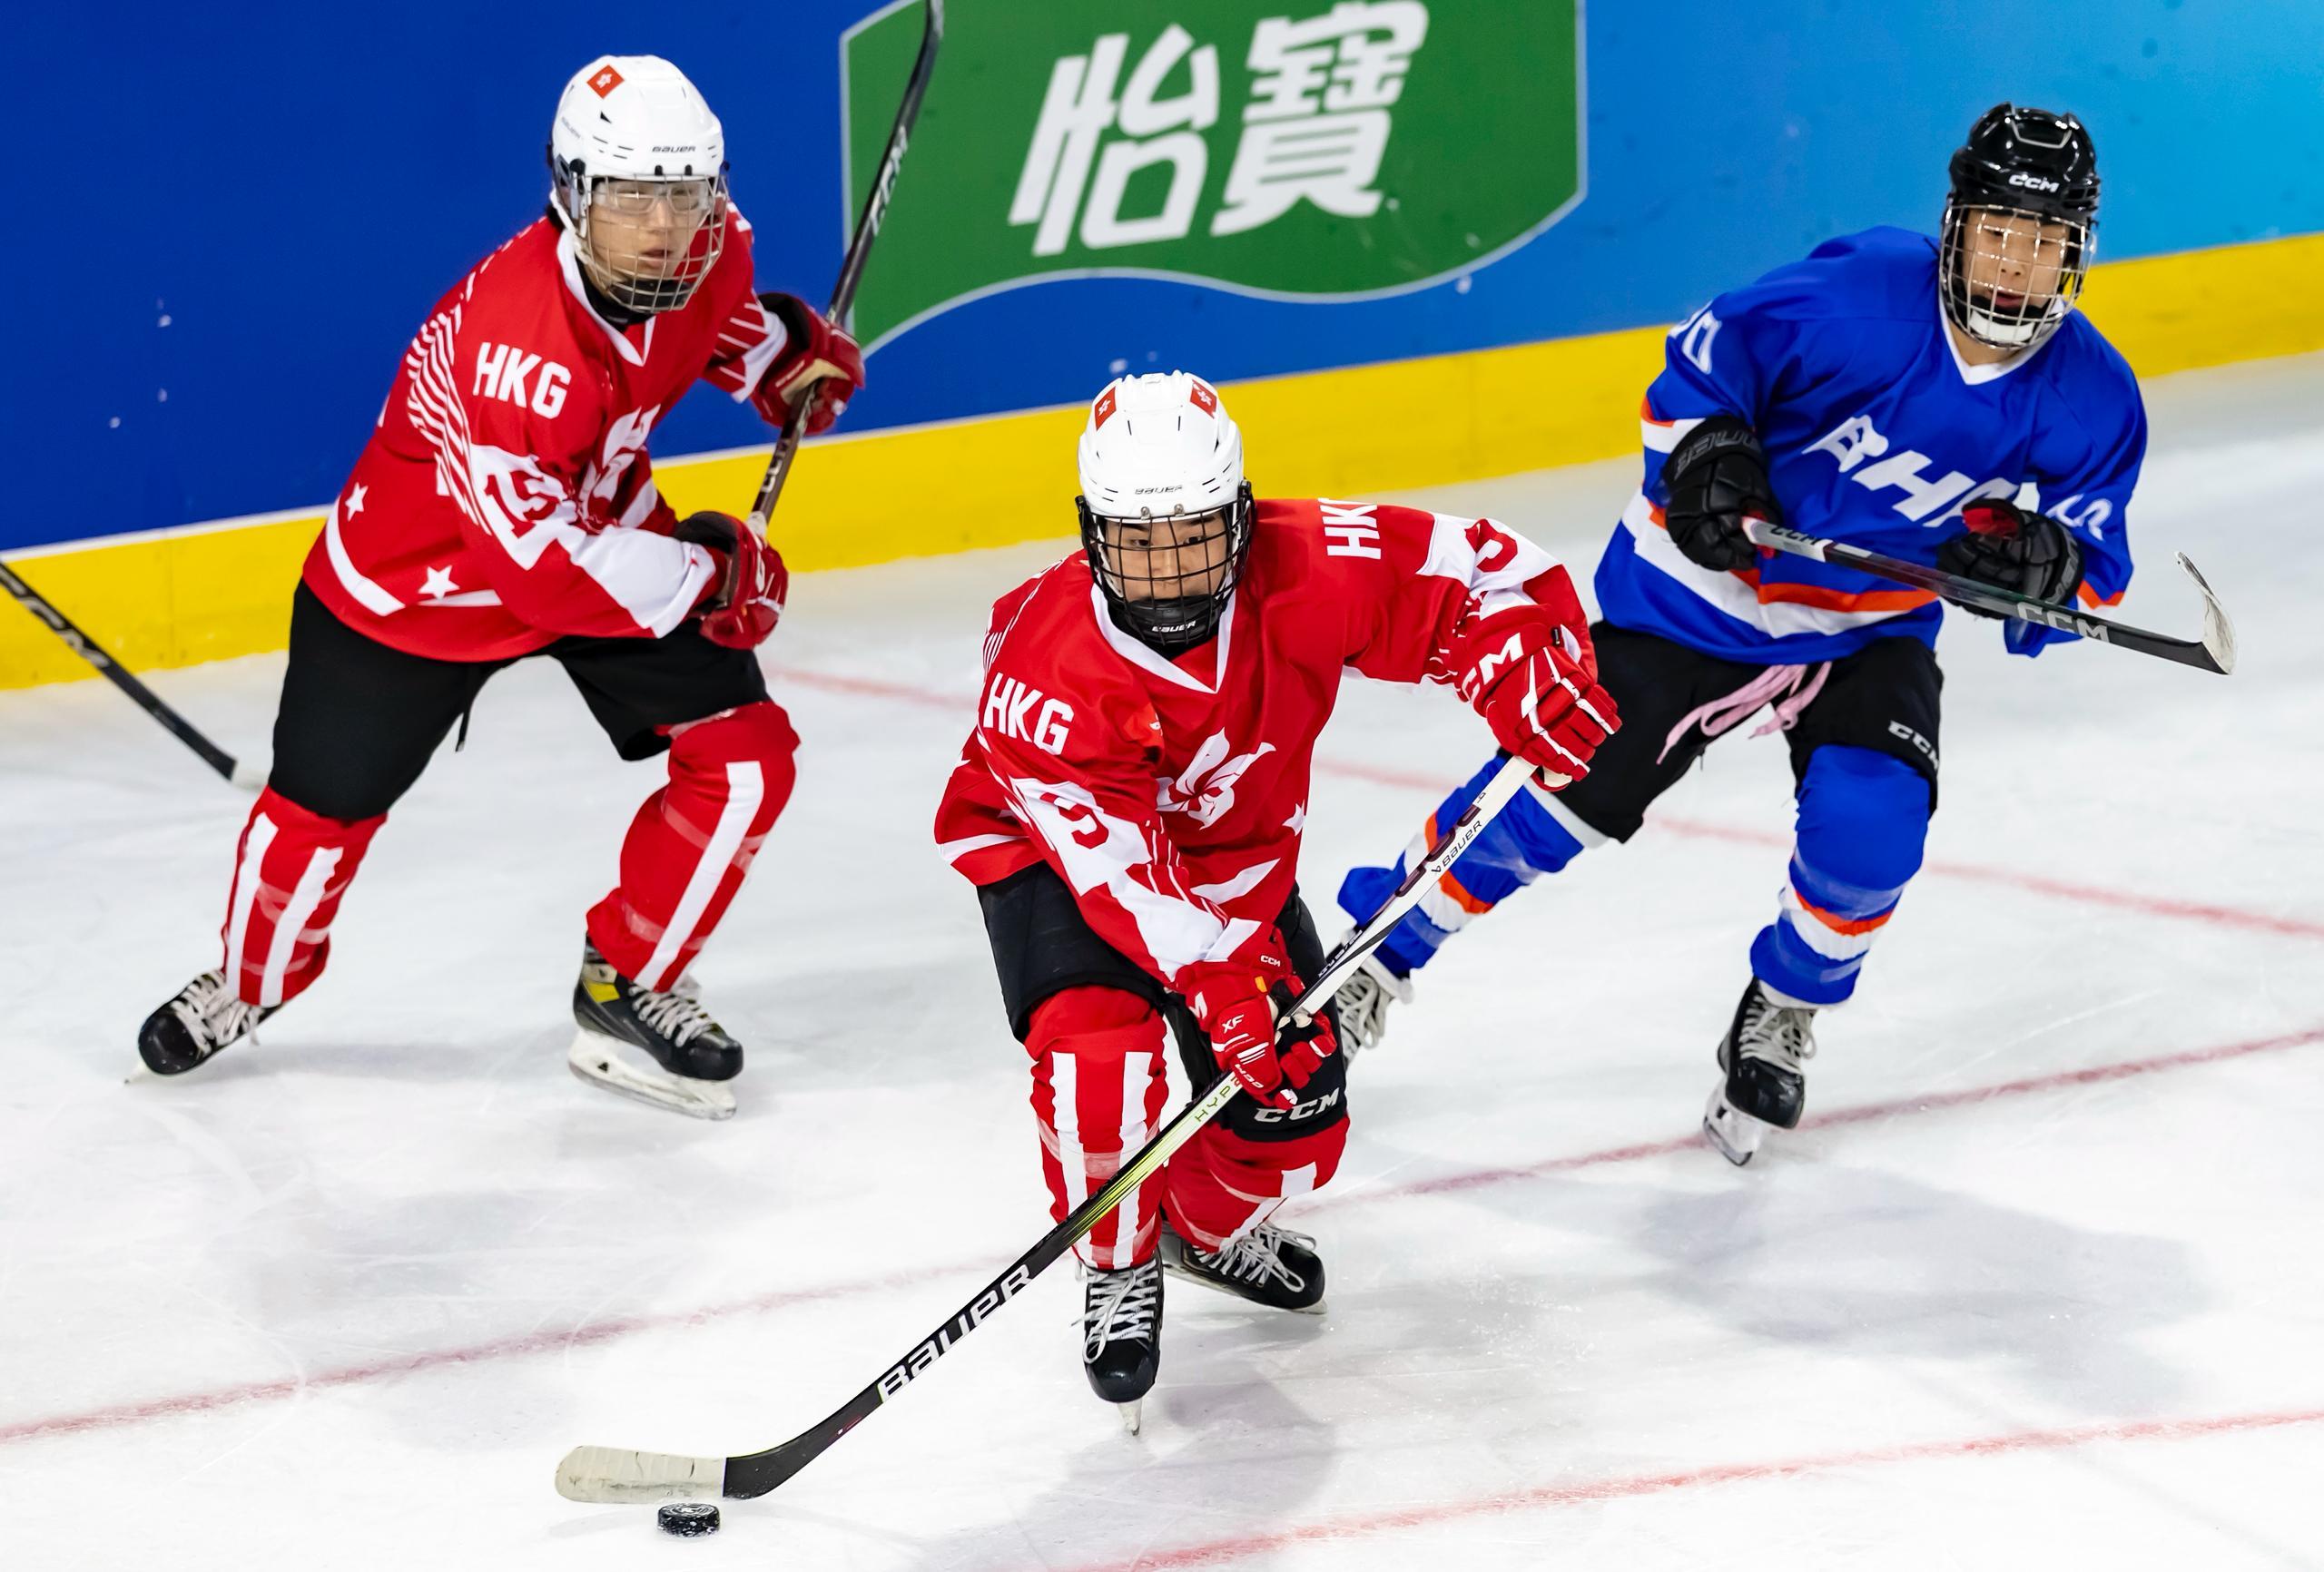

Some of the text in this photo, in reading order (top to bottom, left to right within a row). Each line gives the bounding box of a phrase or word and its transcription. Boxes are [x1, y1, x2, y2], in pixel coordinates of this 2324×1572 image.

[1009, 0, 1430, 257] 怡寶
[2008, 172, 2060, 193] CCM
[473, 341, 573, 420] HKG
[1317, 497, 1383, 561] HK
[2016, 601, 2111, 644] CCM
[982, 672, 1076, 757] HKG
[1887, 719, 1940, 772] CCM
[1441, 820, 1483, 869] BAUER
[1259, 954, 1282, 968] CCM
[1221, 1014, 1246, 1035] XF
[1234, 1063, 1265, 1089] CCM
[1253, 1086, 1340, 1124] CCM
[874, 1263, 1033, 1404] BAUER
